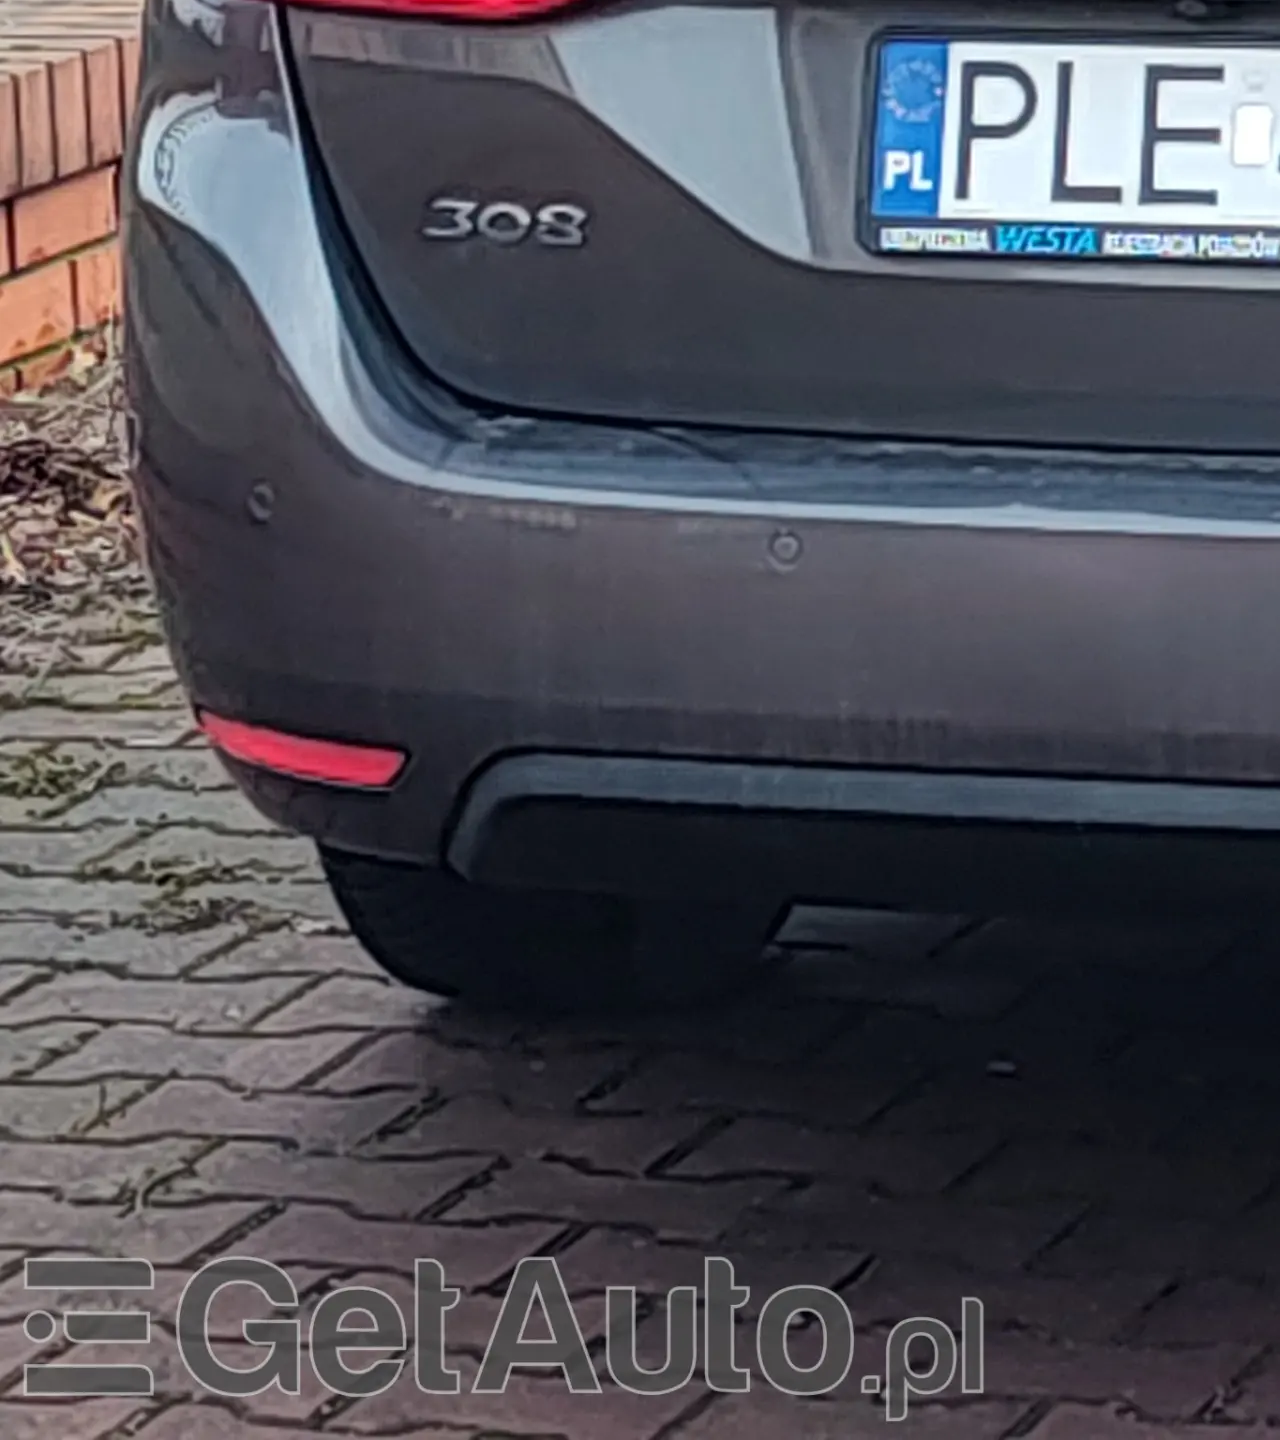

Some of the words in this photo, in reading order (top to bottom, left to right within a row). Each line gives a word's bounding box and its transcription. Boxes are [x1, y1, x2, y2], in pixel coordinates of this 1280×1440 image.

[953, 61, 1226, 206] PLE
[884, 150, 933, 191] PL
[421, 197, 588, 247] 308
[996, 226, 1098, 254] WESTA
